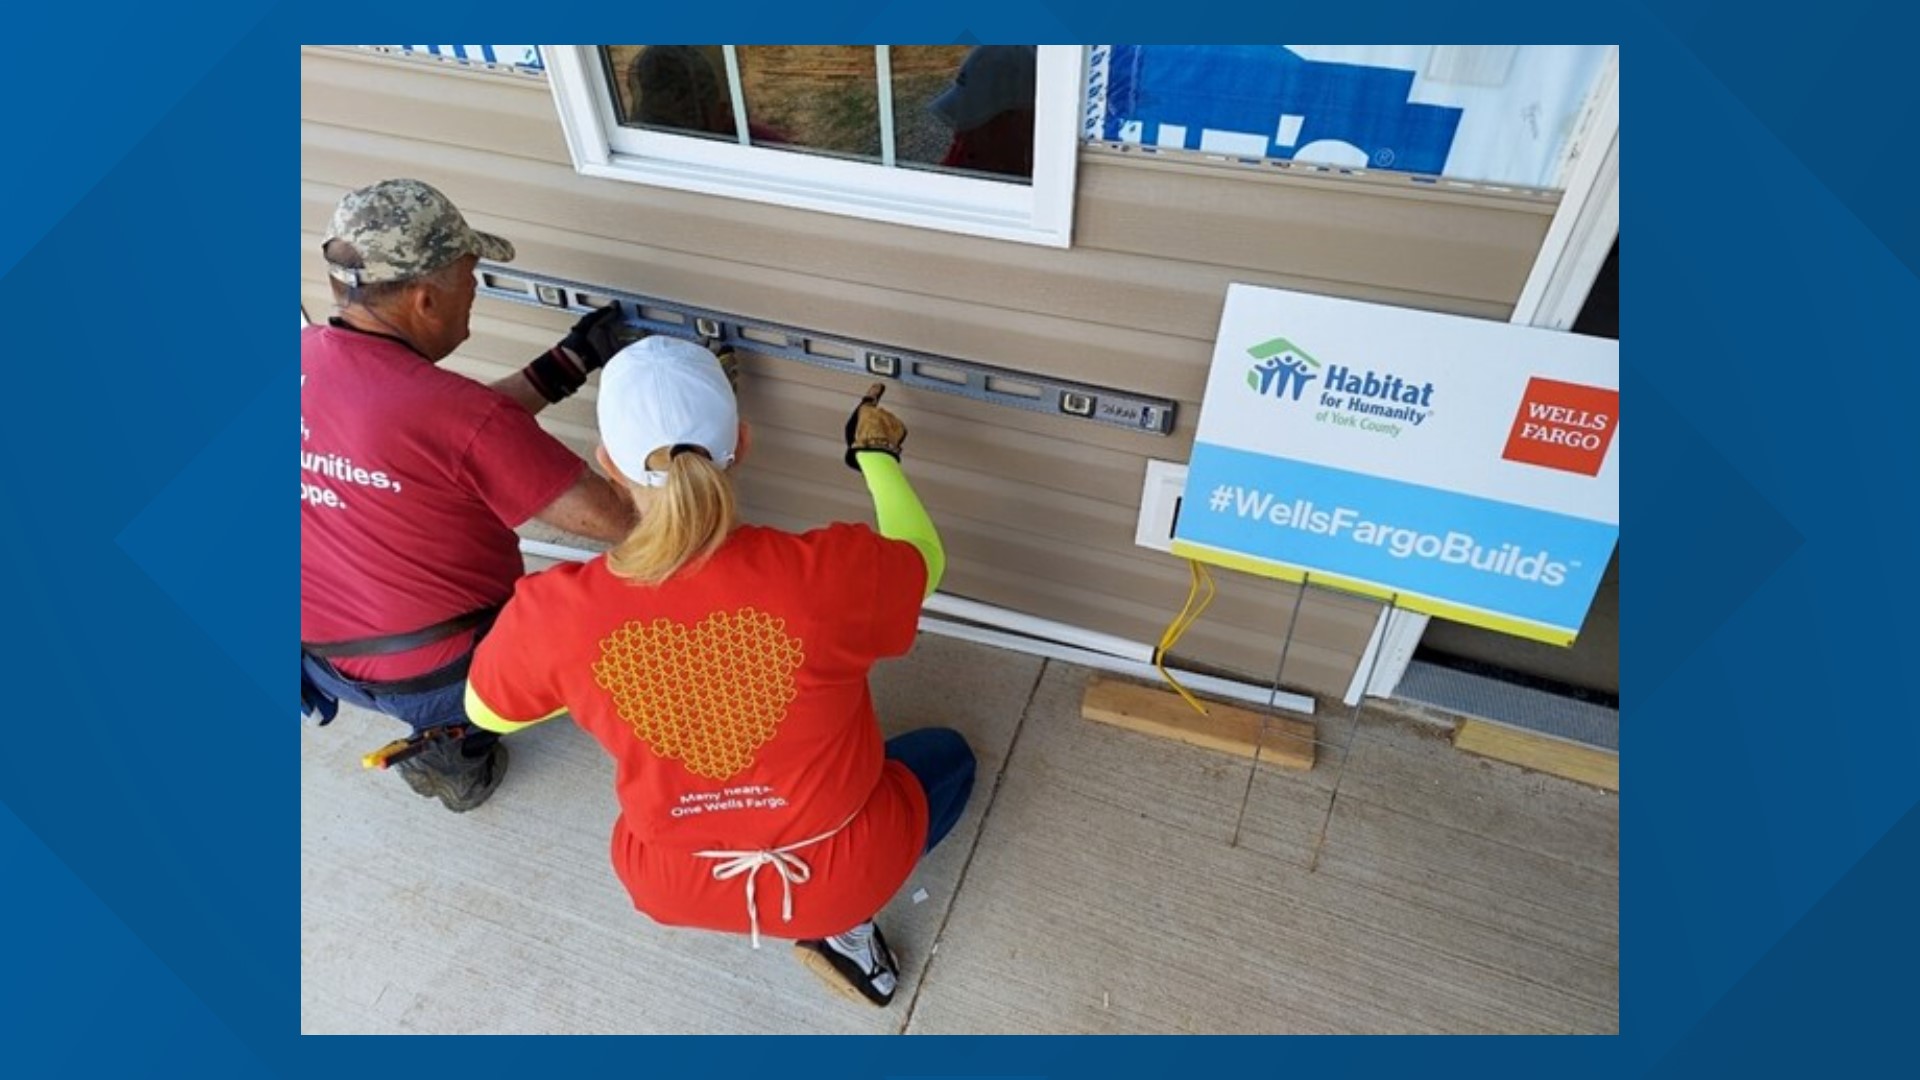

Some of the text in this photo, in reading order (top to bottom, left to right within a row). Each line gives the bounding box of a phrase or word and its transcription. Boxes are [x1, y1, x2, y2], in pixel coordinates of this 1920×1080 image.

[1324, 364, 1434, 407] Habitat
[1320, 391, 1426, 426] for Humanity
[1529, 402, 1609, 430] WELLS
[1315, 411, 1402, 438] of York County
[1521, 422, 1601, 451] FARGO
[1209, 484, 1567, 587] #WellsFargoBuilds
[671, 797, 789, 817] One Wells Fargo.
[680, 792, 721, 804] Many
